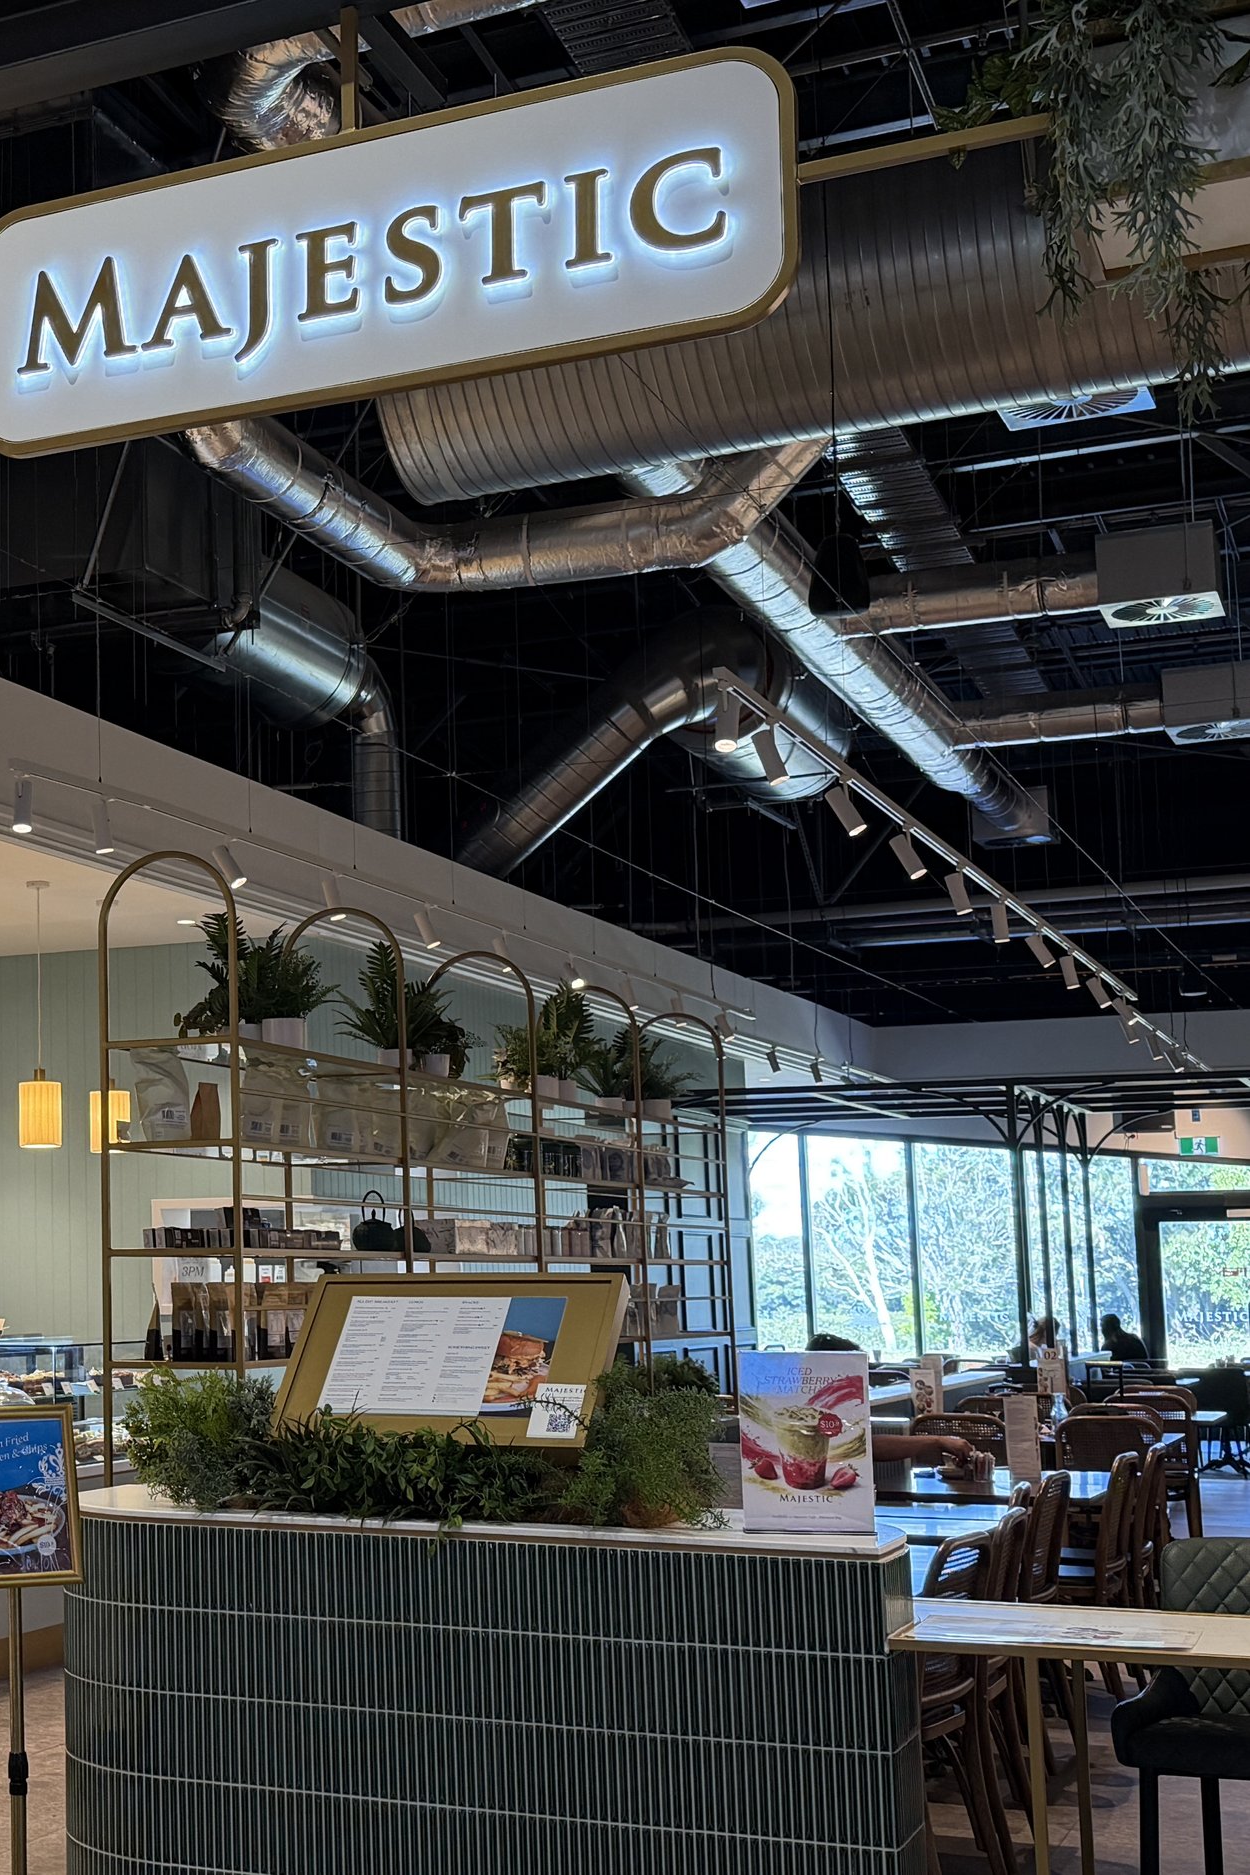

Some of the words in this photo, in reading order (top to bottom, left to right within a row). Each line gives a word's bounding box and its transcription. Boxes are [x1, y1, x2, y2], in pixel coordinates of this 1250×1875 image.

[17, 146, 729, 375] MAJESTIC
[181, 1265, 205, 1277] 3PM
[1174, 1310, 1250, 1323] MAJESTIC
[1044, 1351, 1057, 1360] 02
[787, 1367, 813, 1376] ICED
[764, 1375, 838, 1385] STRAWBERRY
[5, 1431, 30, 1447] Fried
[11, 1448, 20, 1459] &
[779, 1493, 834, 1504] MAJESTIC
